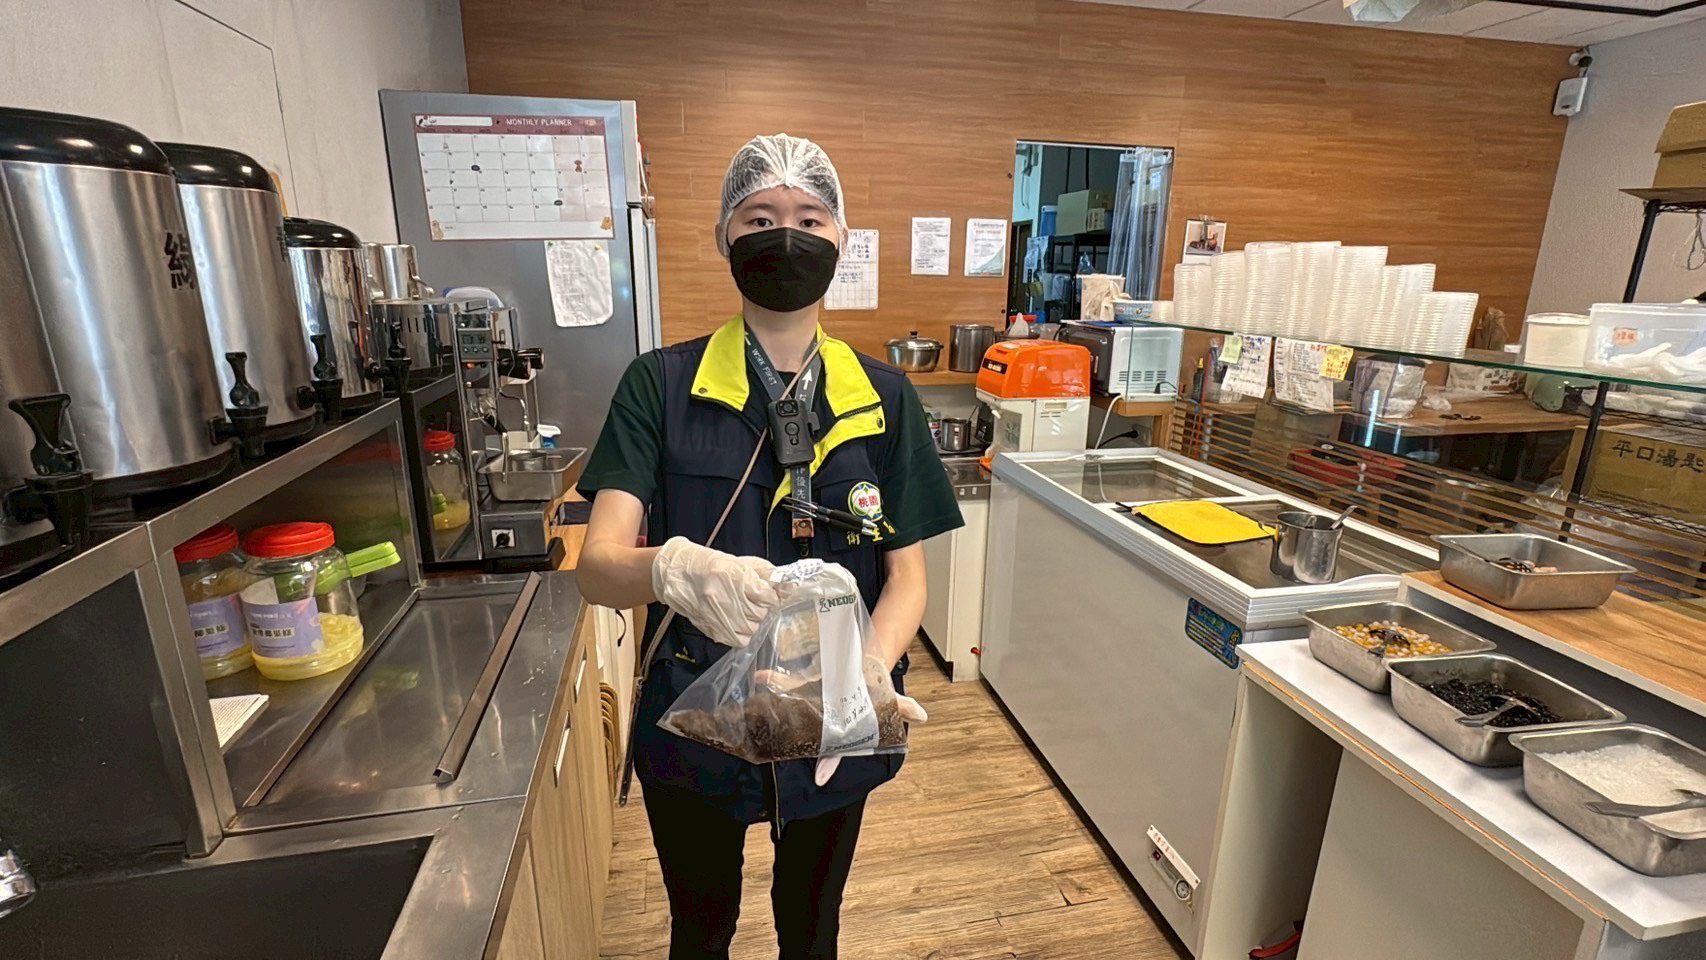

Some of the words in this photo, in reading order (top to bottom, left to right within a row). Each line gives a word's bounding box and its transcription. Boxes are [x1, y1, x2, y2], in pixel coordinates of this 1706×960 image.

[506, 118, 538, 126] MONTHLY
[541, 118, 572, 127] PLANNER
[1612, 439, 1704, 473] 平口湯匙
[858, 495, 879, 508] 桃園
